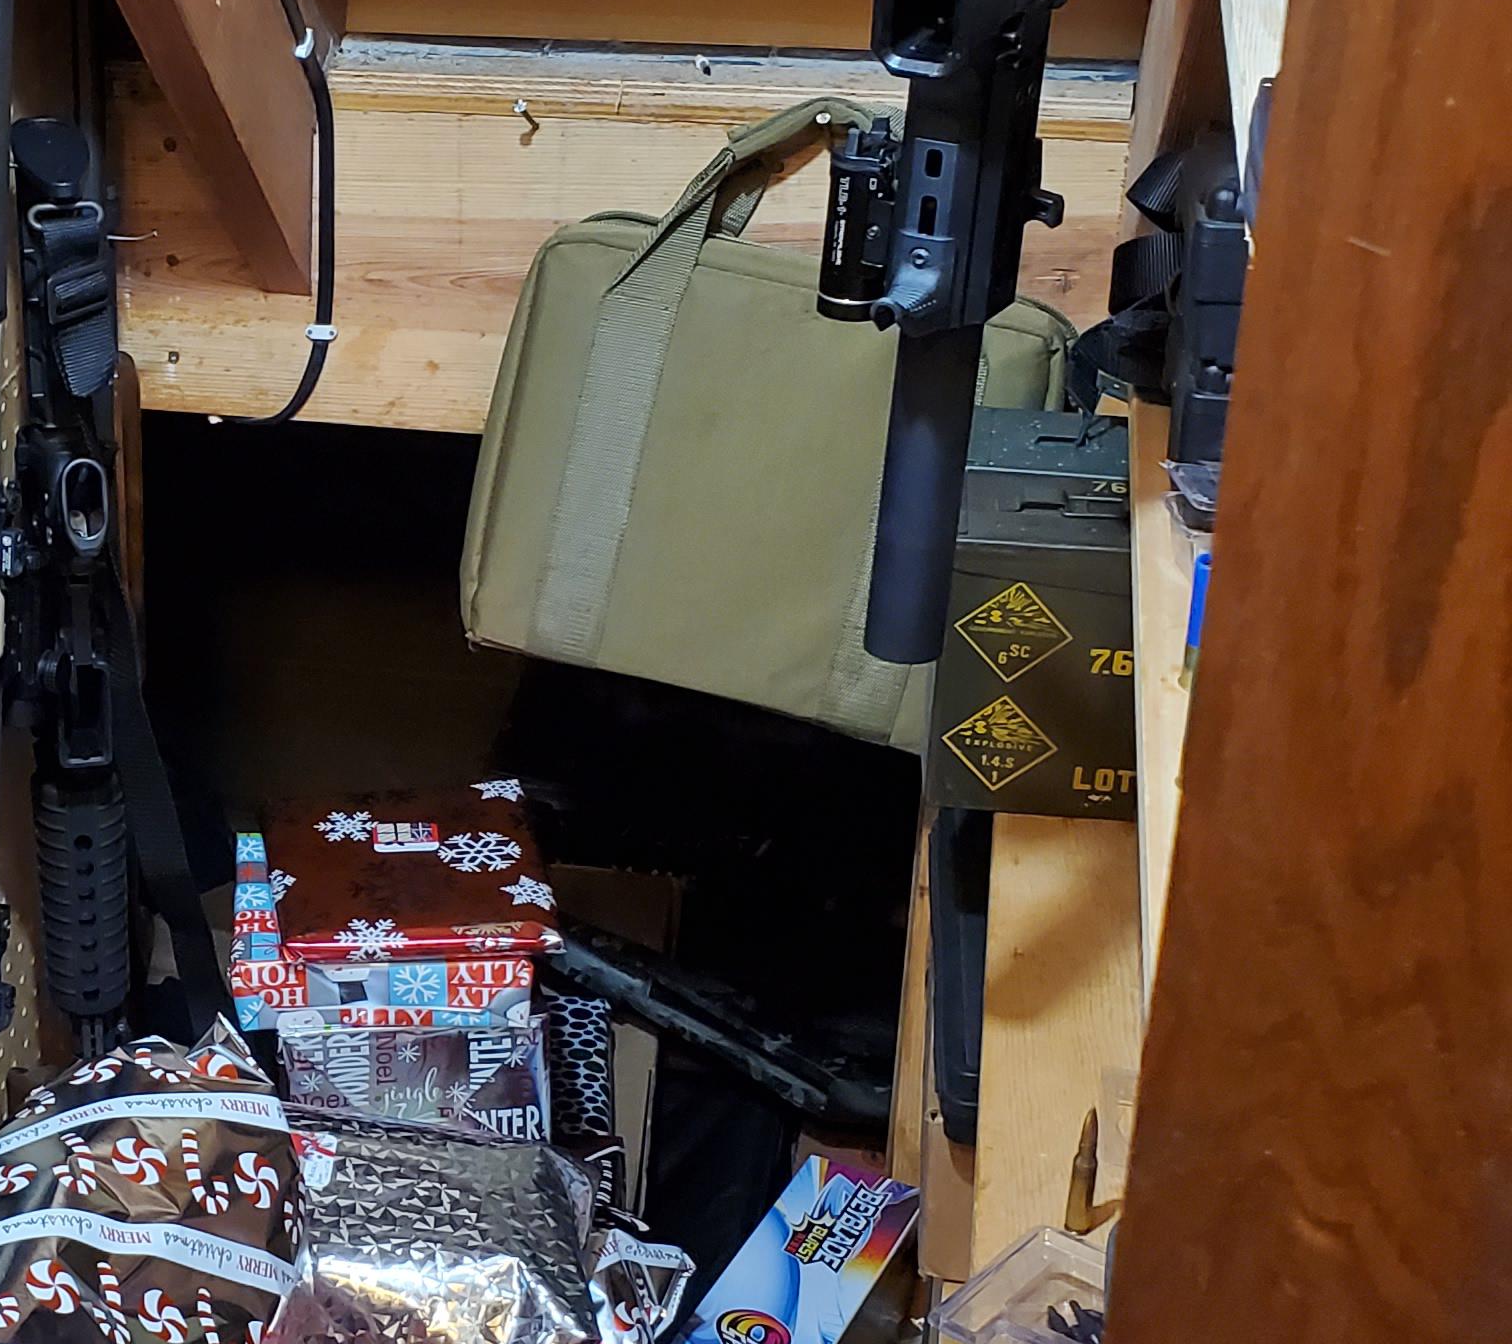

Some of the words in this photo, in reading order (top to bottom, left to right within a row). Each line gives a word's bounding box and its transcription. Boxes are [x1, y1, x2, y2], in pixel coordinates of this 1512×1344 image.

[964, 737, 1033, 753] EXPLOSIVE
[1072, 765, 1136, 793] LOT
[57, 1103, 114, 1126] MERRY
[124, 1097, 212, 1117] christmas
[220, 1099, 270, 1117] MERRY
[1, 1212, 93, 1236] christmas
[98, 1223, 152, 1245] MERRY
[813, 1188, 885, 1271] BEYBLADE
[163, 1231, 233, 1267] christmas
[796, 1225, 829, 1262] BURST
[235, 1254, 279, 1278] MERRY
